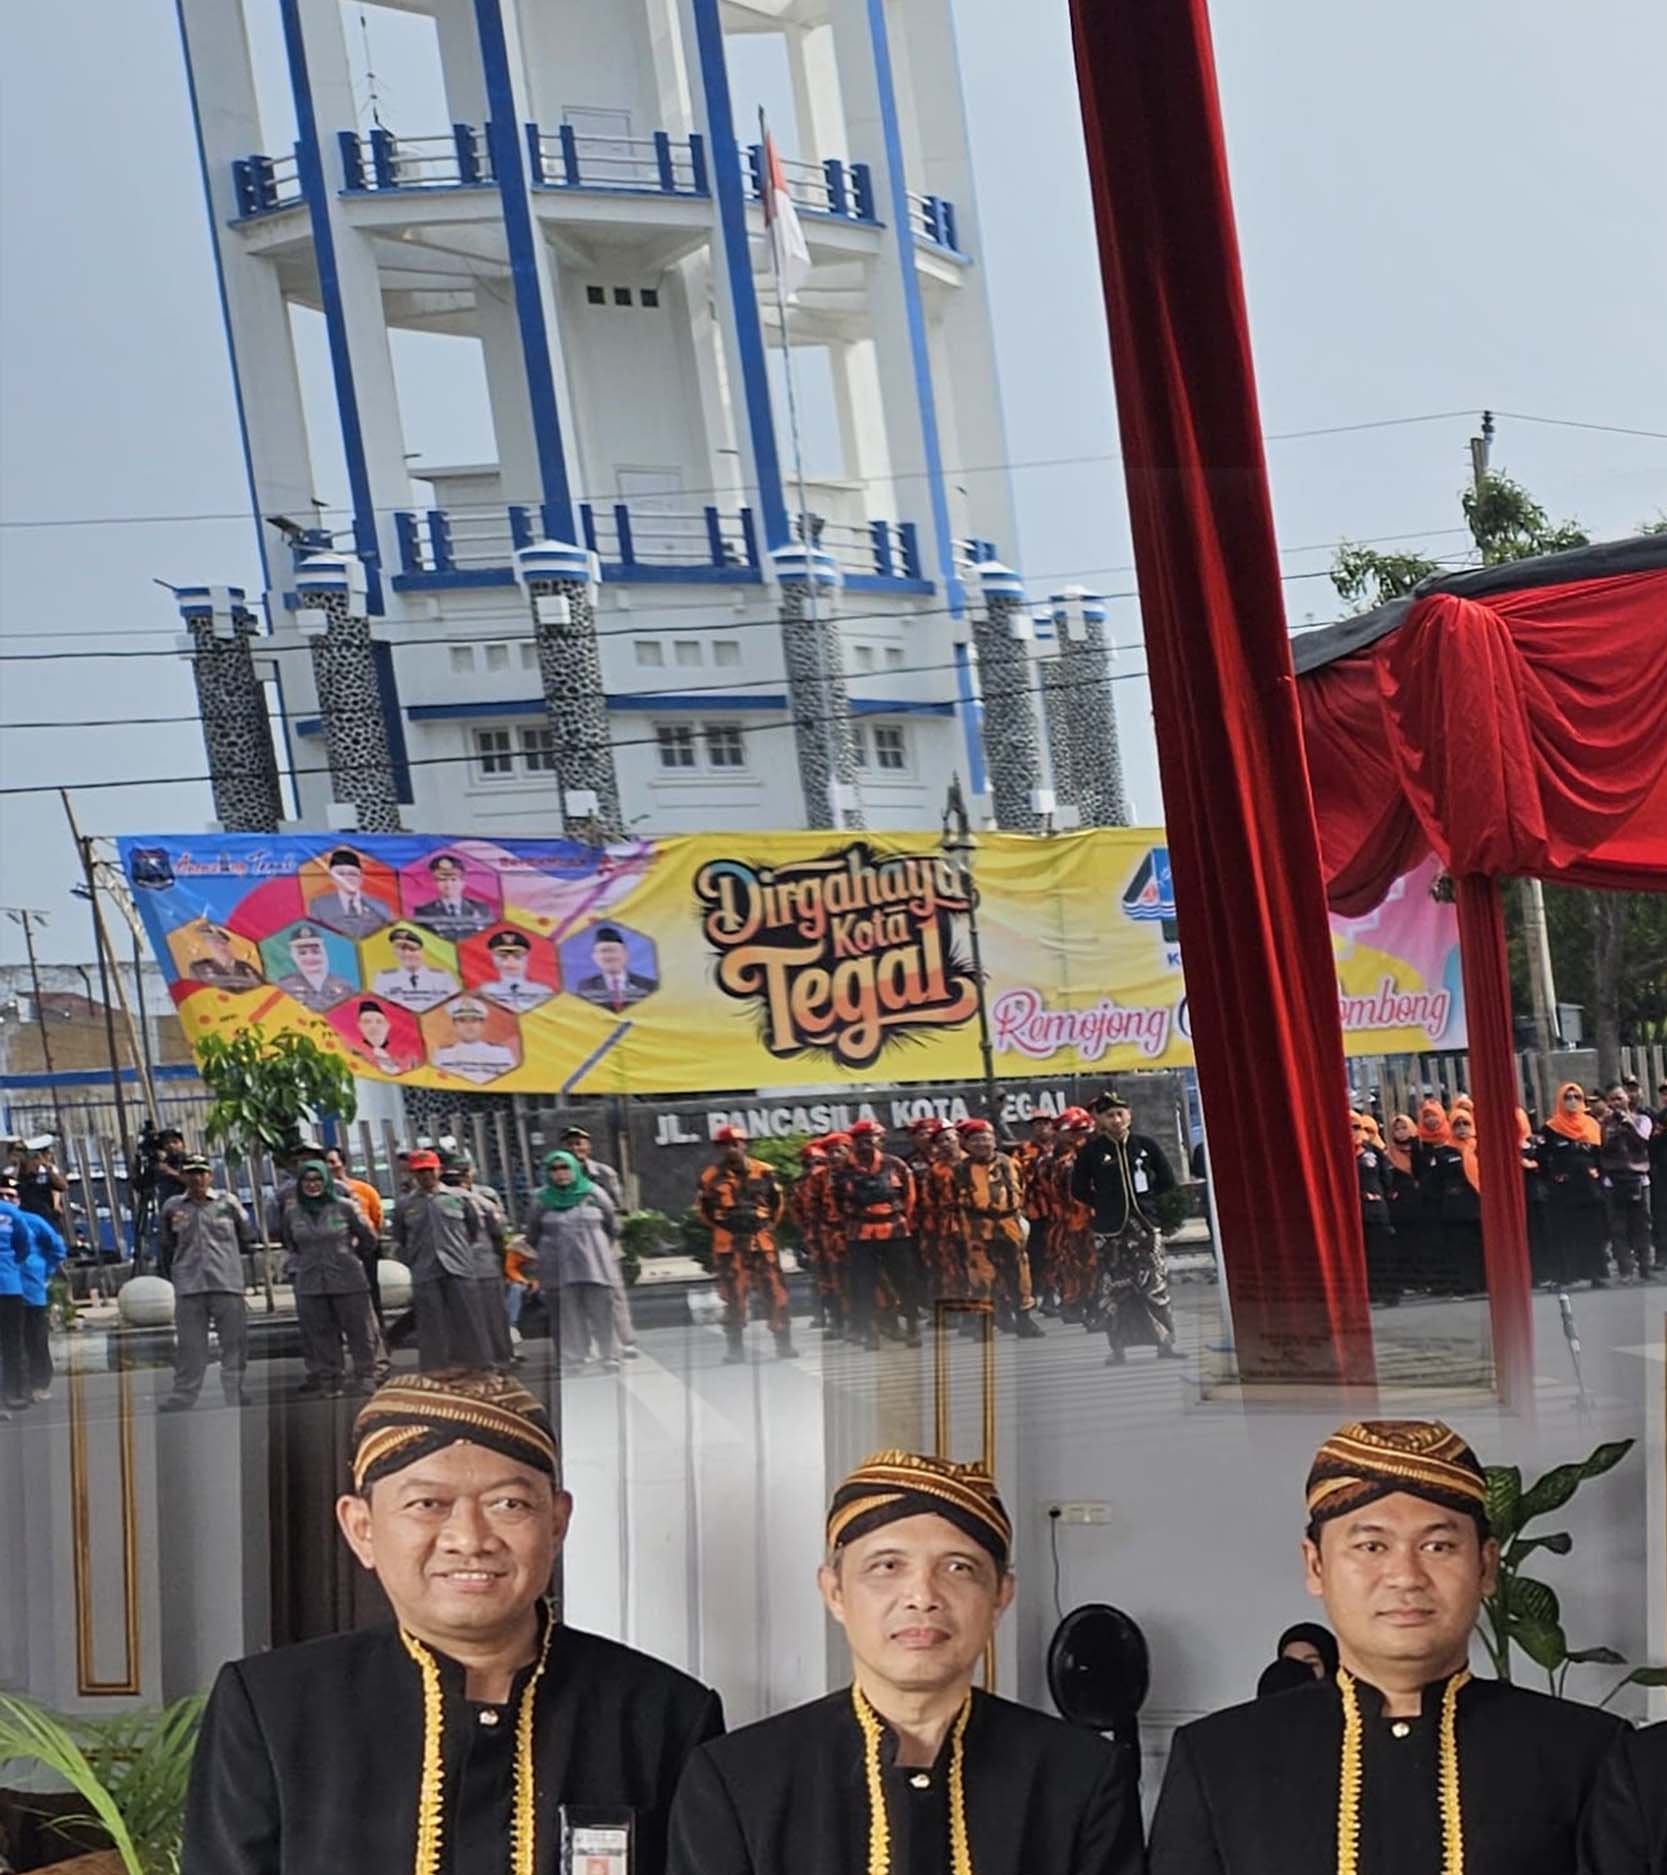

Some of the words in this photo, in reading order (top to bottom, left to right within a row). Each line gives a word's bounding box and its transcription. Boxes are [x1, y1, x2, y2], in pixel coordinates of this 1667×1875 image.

[695, 849, 971, 944] Dirgahayu
[831, 905, 911, 959] Kota
[719, 912, 979, 1060] Tegal
[656, 1114, 697, 1147] JL.
[892, 1096, 968, 1129] KOTA
